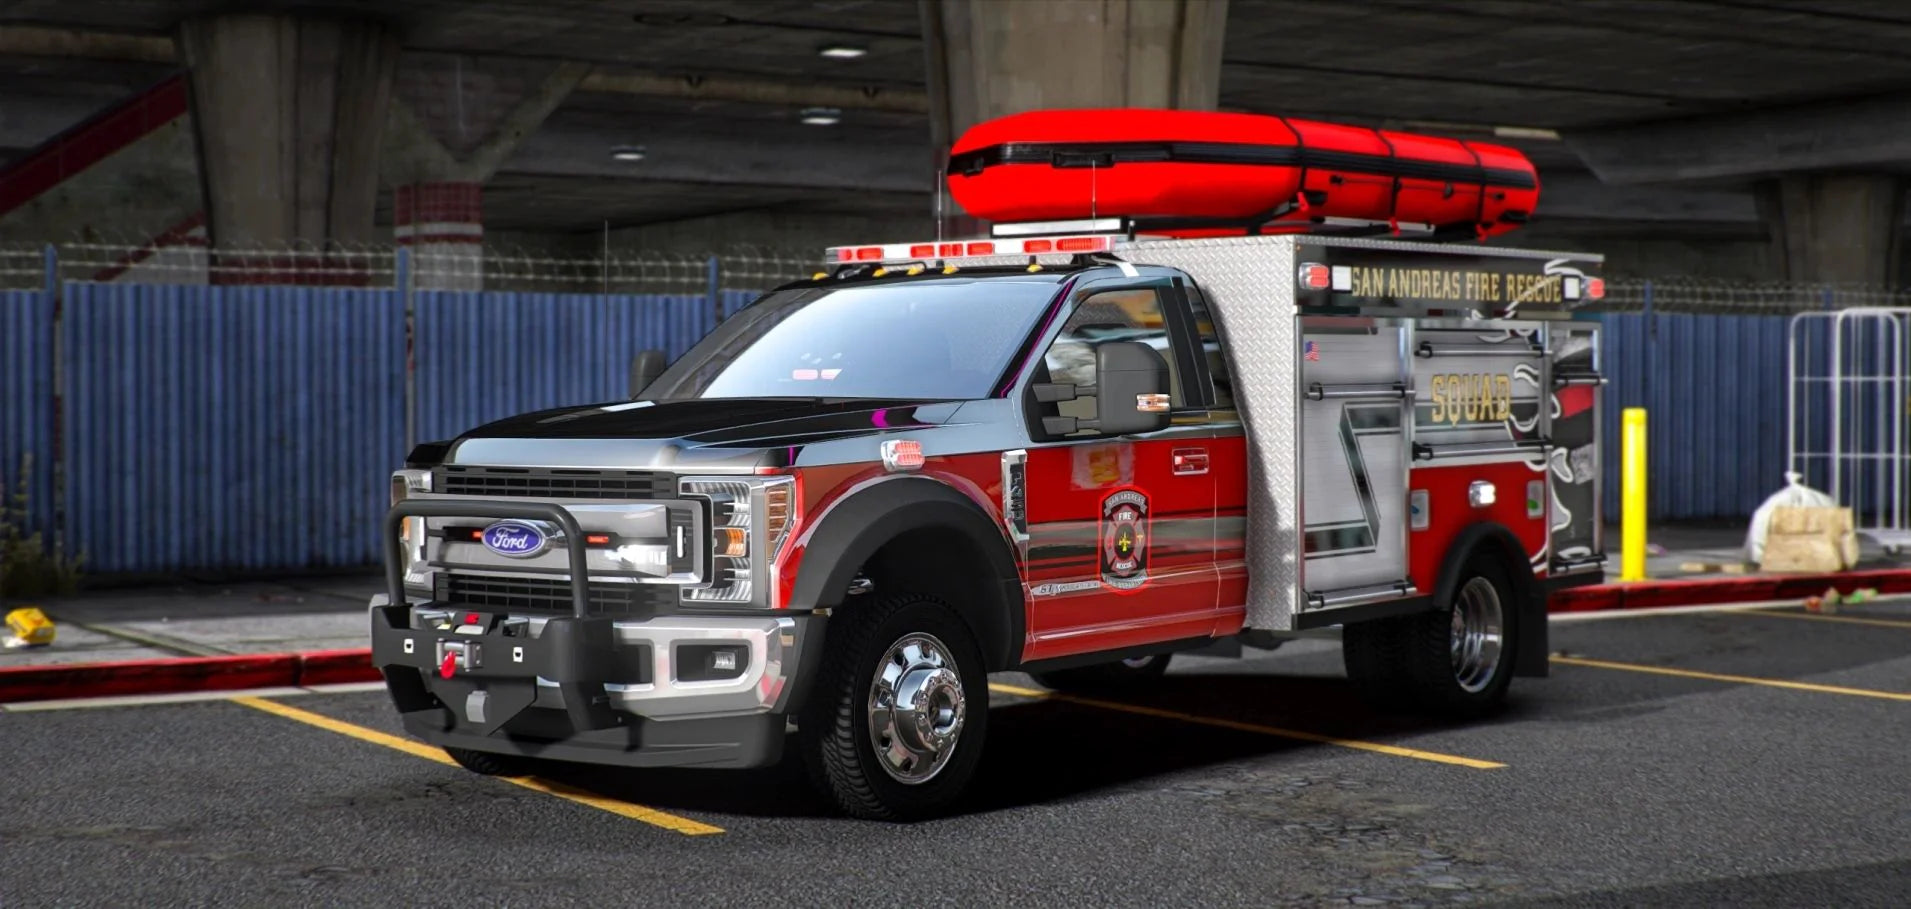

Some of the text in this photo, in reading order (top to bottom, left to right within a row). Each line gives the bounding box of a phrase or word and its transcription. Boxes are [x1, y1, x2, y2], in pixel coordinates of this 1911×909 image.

[1351, 266, 1562, 303] SAN ANDREAS FIRE RESCUE
[1432, 373, 1511, 427] SQUAD
[1118, 511, 1132, 521] FIRE
[492, 526, 529, 549] Ford
